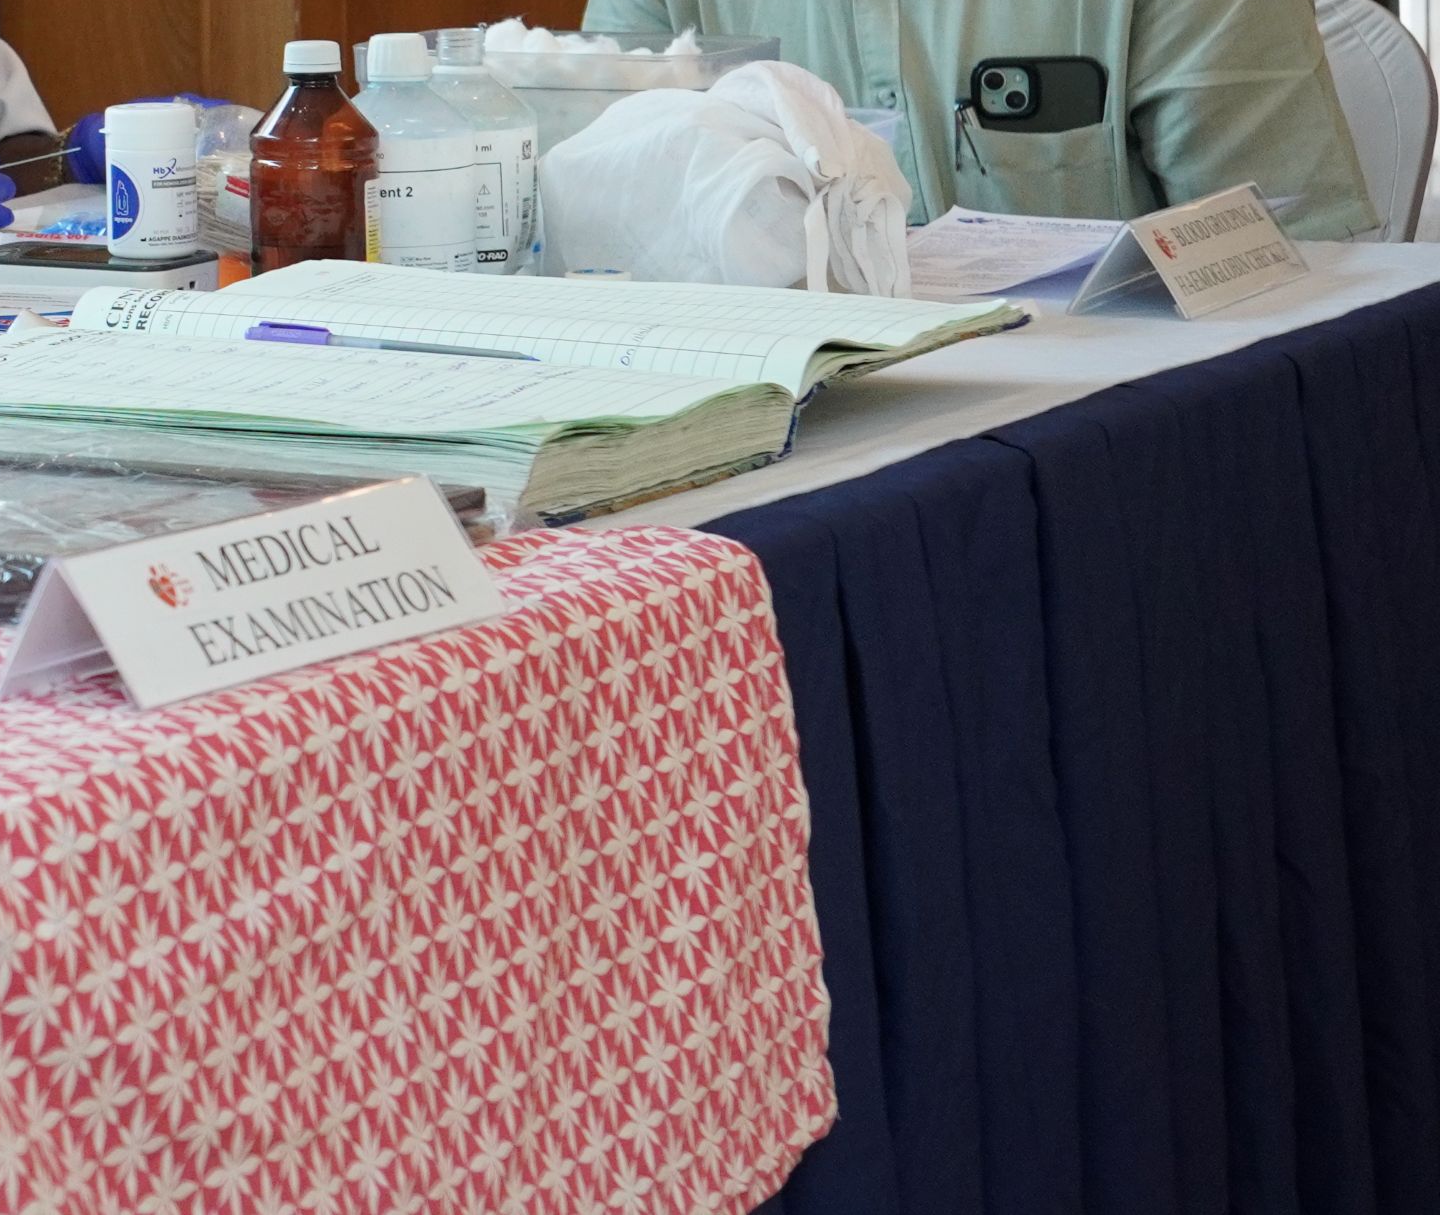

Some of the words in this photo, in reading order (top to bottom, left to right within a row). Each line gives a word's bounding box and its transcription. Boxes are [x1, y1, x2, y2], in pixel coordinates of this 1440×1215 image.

[405, 186, 414, 198] 2
[1170, 219, 1211, 247] BLOOD
[193, 515, 381, 592] MEDICAL
[187, 565, 458, 668] EXAMINATION
